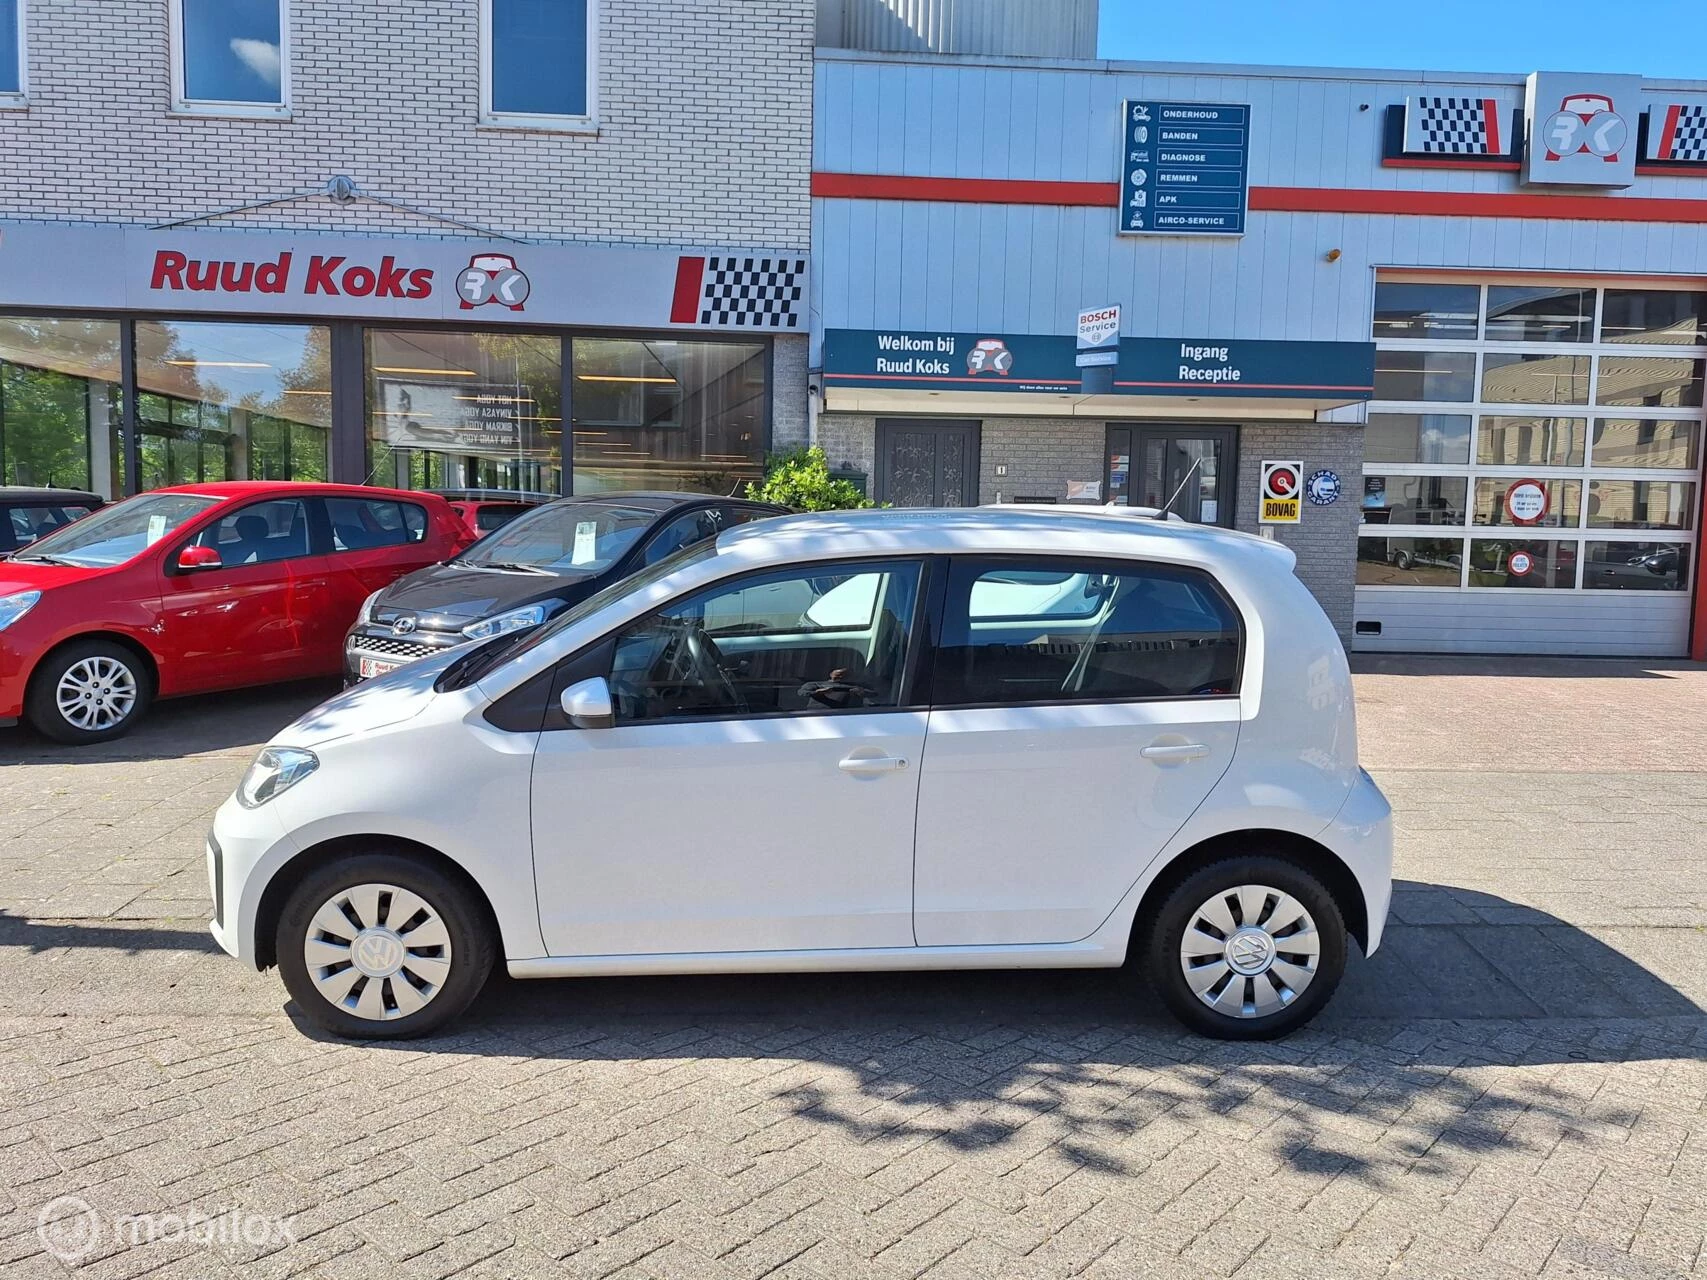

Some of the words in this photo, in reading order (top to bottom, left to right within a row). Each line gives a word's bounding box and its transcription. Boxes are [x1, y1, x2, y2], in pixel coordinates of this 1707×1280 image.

[1163, 110, 1218, 119] ONDERHOUD
[1162, 132, 1198, 140] BANDEN
[1161, 153, 1206, 162] DIAGNOSE
[1160, 174, 1198, 182] REMMEN
[1158, 216, 1225, 225] AIRCO-SERVICE
[150, 250, 293, 294] Ruud
[304, 255, 434, 299] Koks
[1080, 309, 1117, 324] BOSCH
[1079, 321, 1116, 333] Service
[878, 335, 934, 351] Welkom
[937, 336, 955, 355] bij
[1181, 343, 1229, 362] Ingang
[876, 357, 912, 373] Ruud
[916, 358, 950, 374] Koks
[1179, 365, 1241, 383] Receptie
[1308, 471, 1340, 486] SCHADE
[1265, 502, 1296, 517] BOVAG
